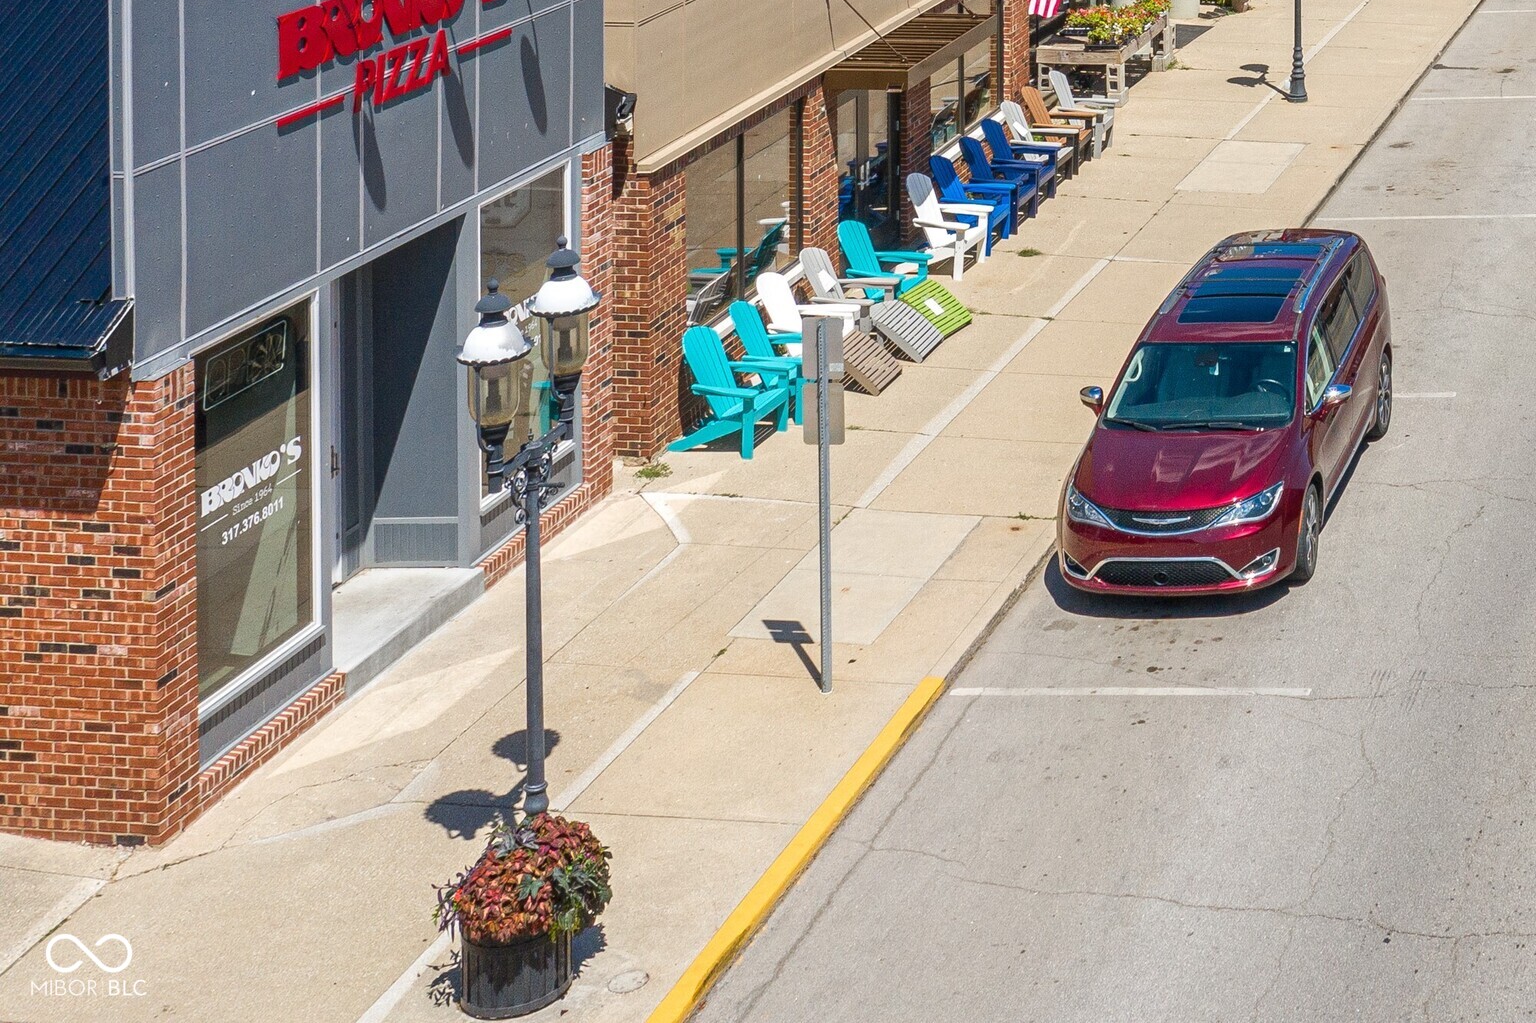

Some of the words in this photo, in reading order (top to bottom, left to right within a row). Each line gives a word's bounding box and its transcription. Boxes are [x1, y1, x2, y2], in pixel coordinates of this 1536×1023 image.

[352, 29, 449, 114] PIZZA
[200, 436, 302, 518] BRONKO'S
[232, 497, 253, 516] Since
[254, 483, 273, 502] 1964
[221, 496, 284, 545] 317.376.8011
